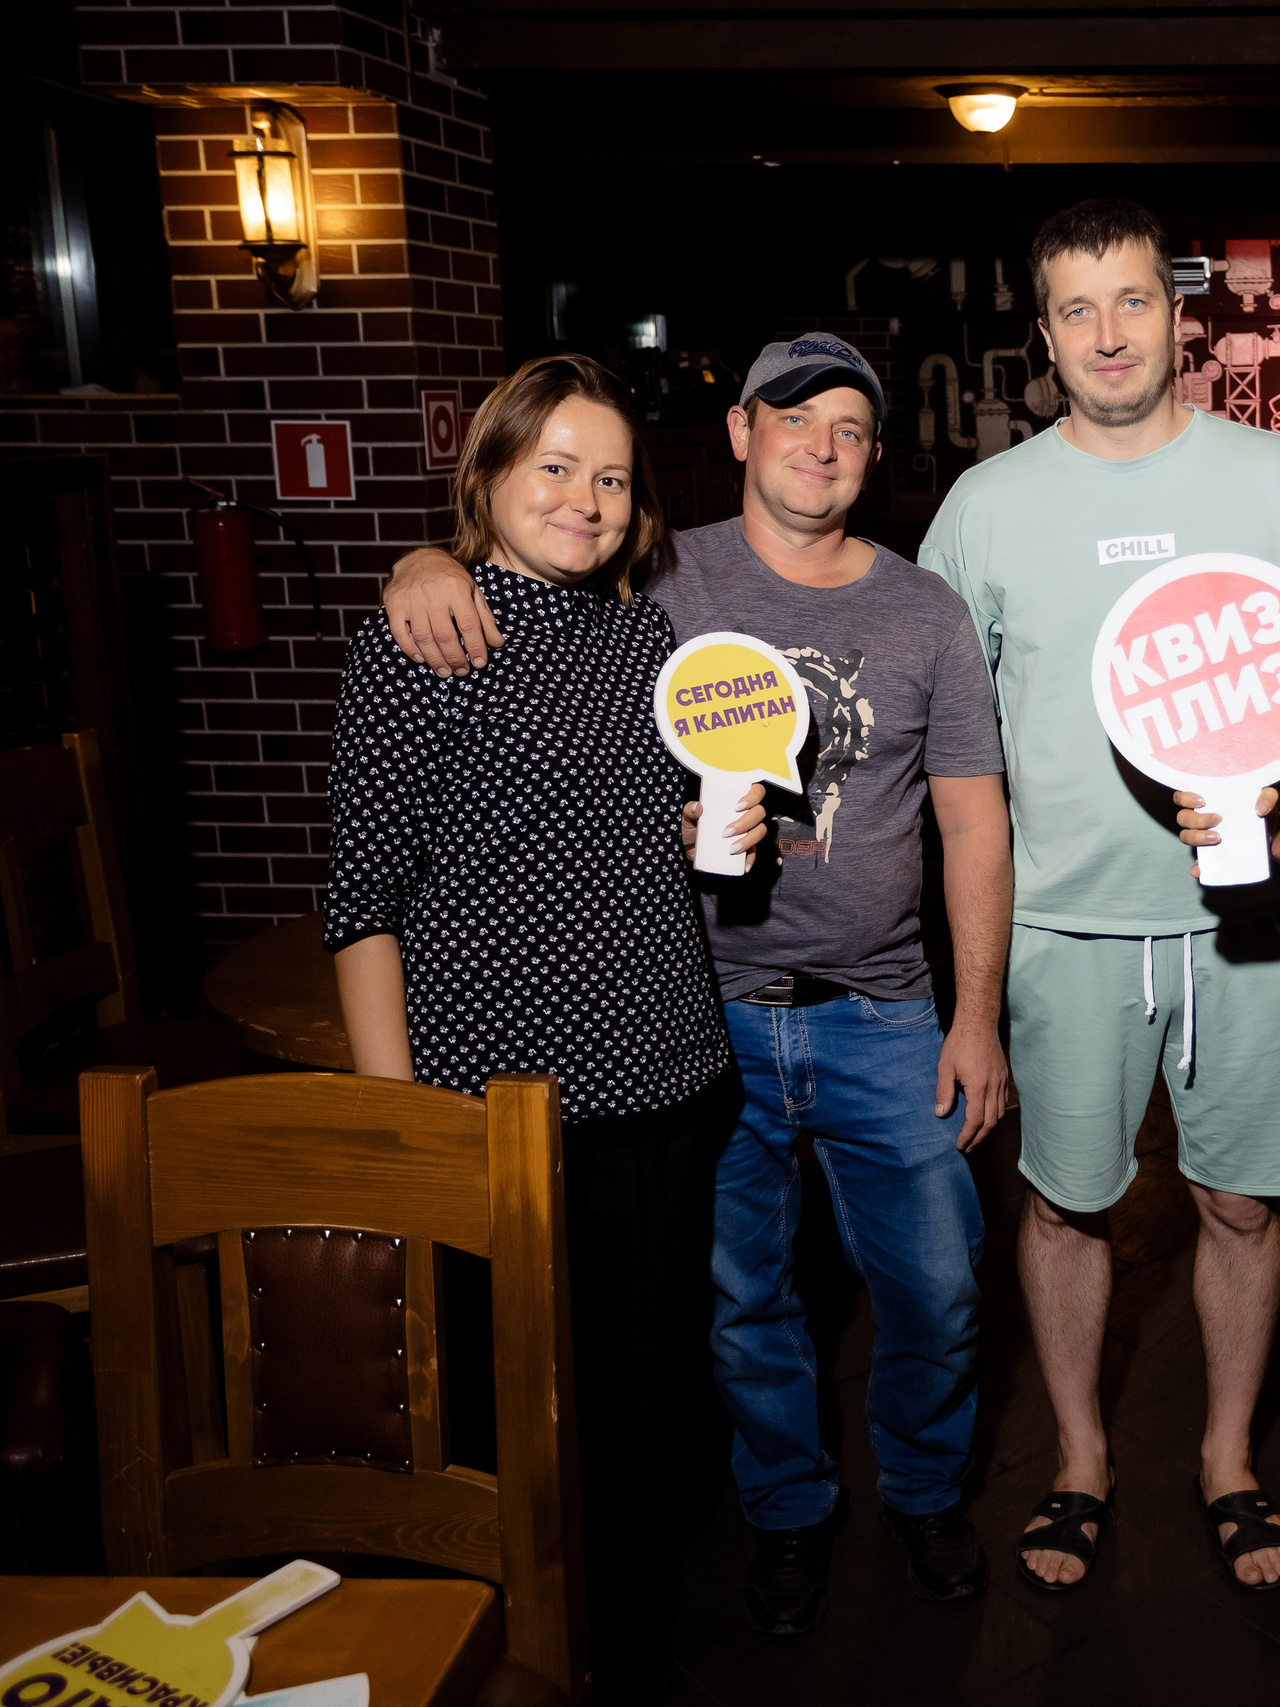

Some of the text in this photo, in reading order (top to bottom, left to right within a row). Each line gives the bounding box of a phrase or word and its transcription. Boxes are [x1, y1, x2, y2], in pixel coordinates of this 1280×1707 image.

[1105, 539, 1169, 559] CHILL
[675, 670, 778, 706] СЕГОДНЯ
[674, 695, 796, 737] Я КАПИТАН
